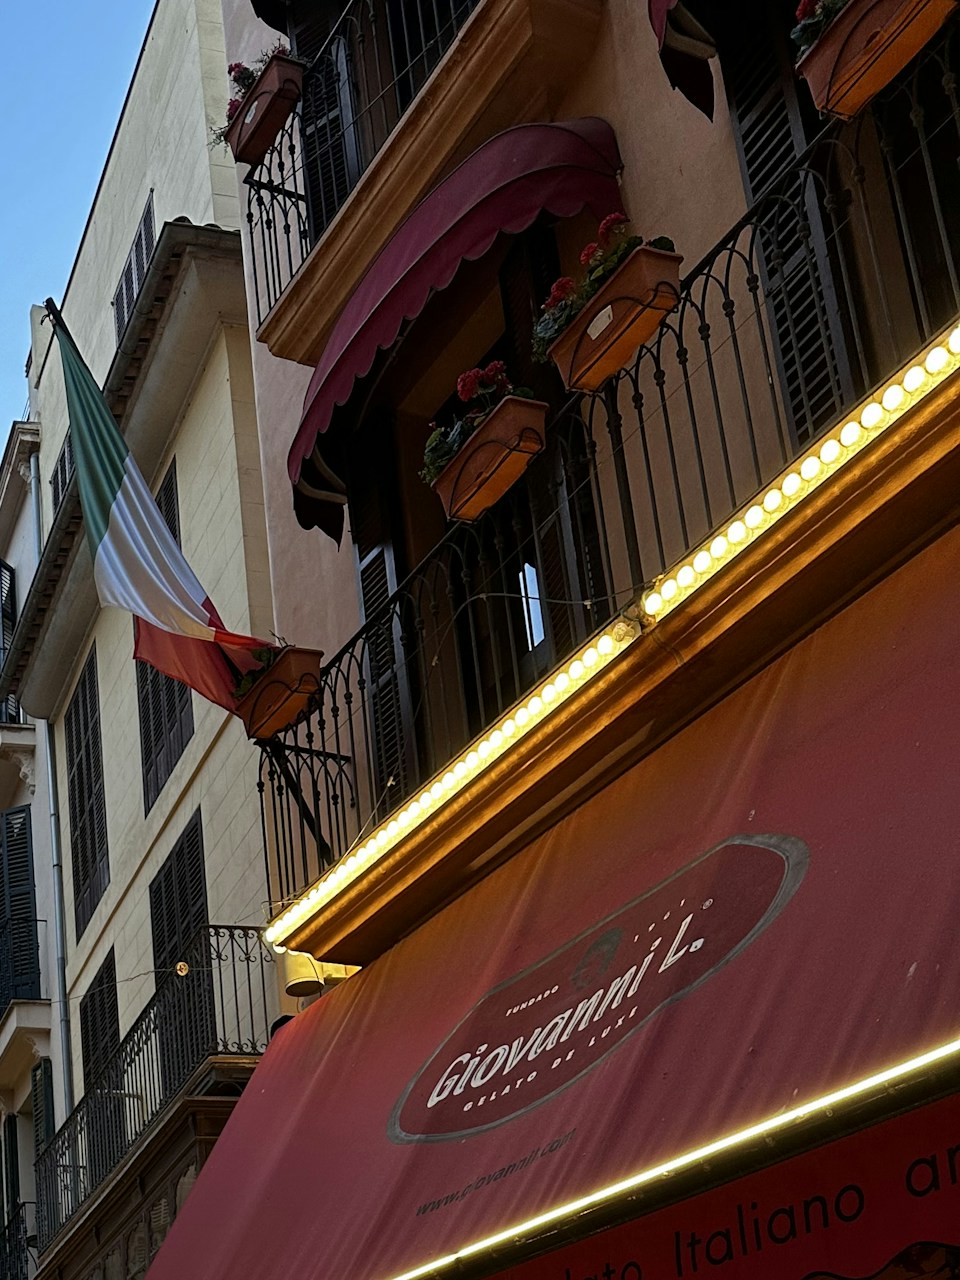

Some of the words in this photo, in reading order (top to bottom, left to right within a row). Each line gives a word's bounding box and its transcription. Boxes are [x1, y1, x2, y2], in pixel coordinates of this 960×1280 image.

[426, 937, 661, 1108] Giovanni
[657, 913, 705, 974] L.
[505, 985, 560, 1017] FUNDADO
[462, 1071, 537, 1112] GELATO
[551, 1049, 575, 1069] DE
[588, 1005, 638, 1047] LUXE
[673, 1183, 866, 1279] Italiano
